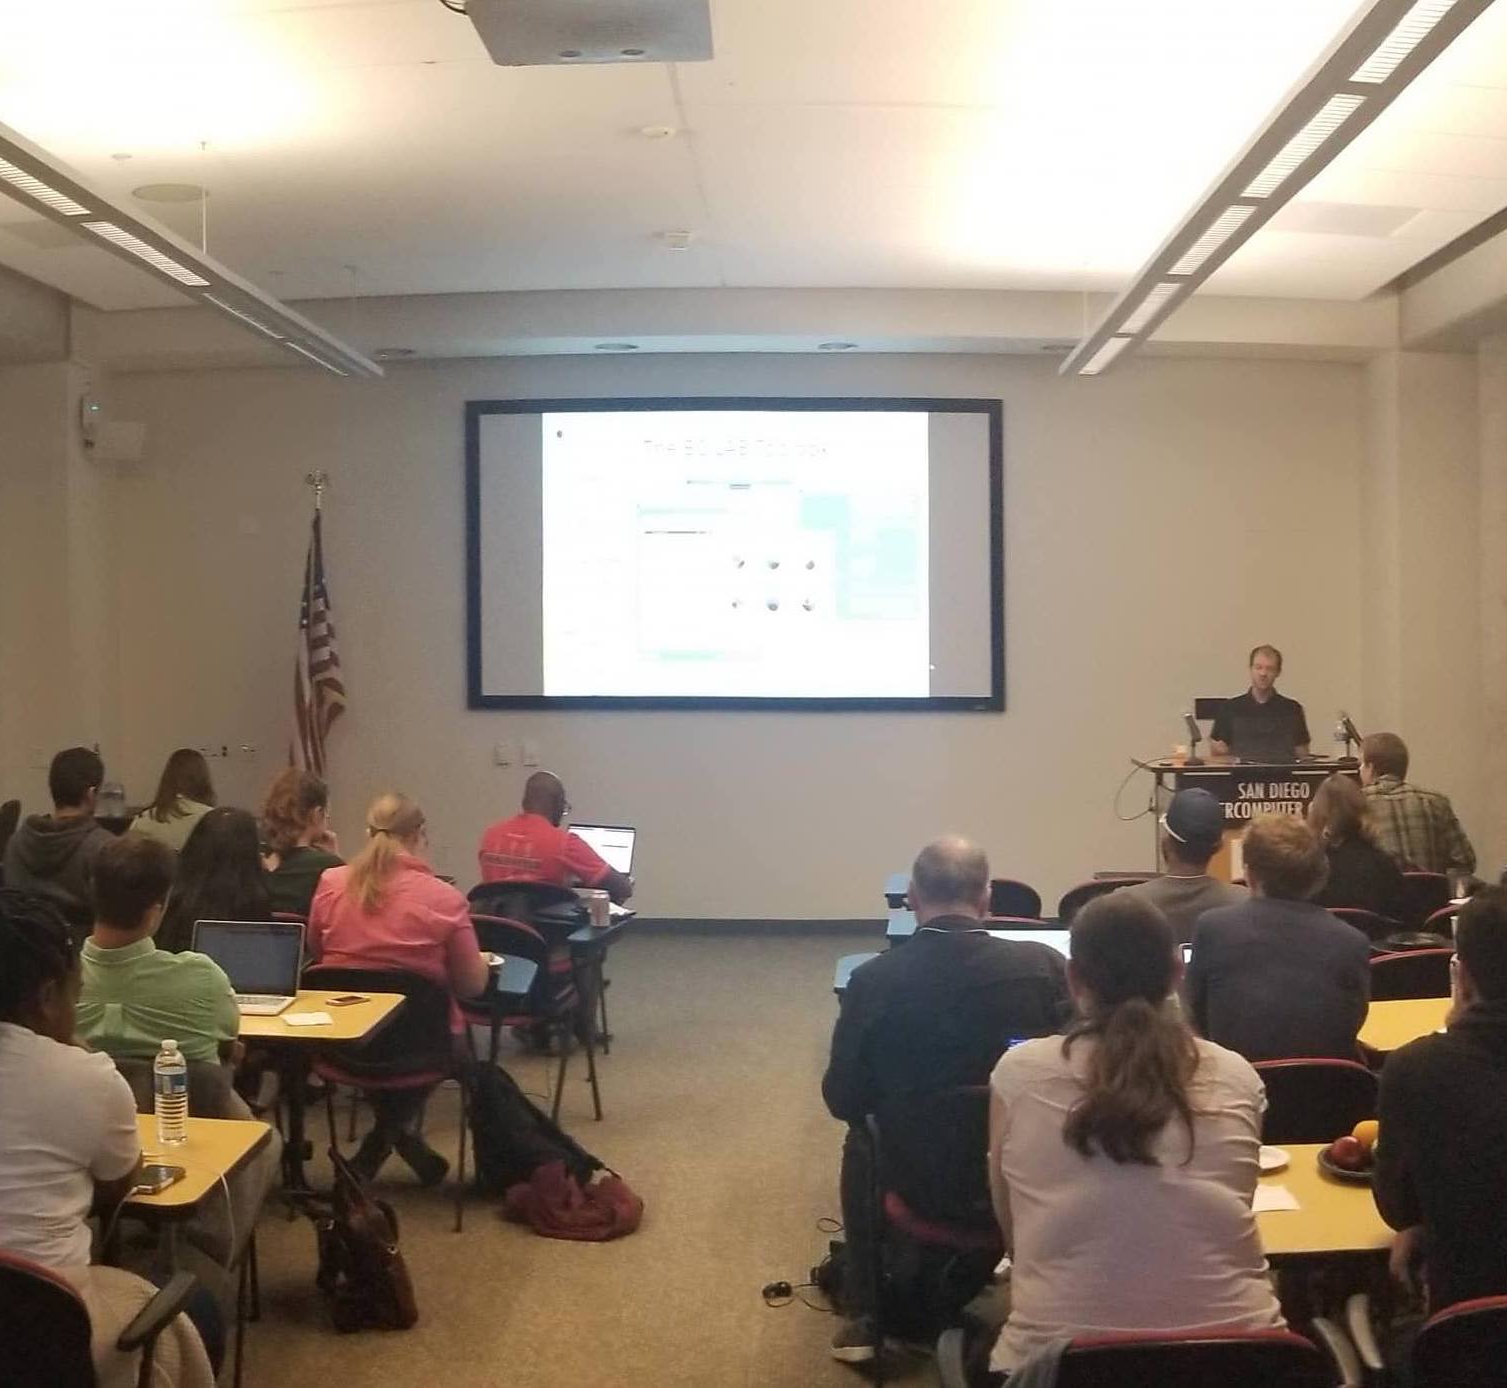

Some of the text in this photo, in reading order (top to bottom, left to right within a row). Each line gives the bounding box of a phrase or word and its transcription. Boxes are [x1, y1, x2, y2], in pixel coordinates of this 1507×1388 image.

[1238, 782, 1310, 799] SAN DIEGO
[1219, 801, 1303, 819] RCOMPUTER
